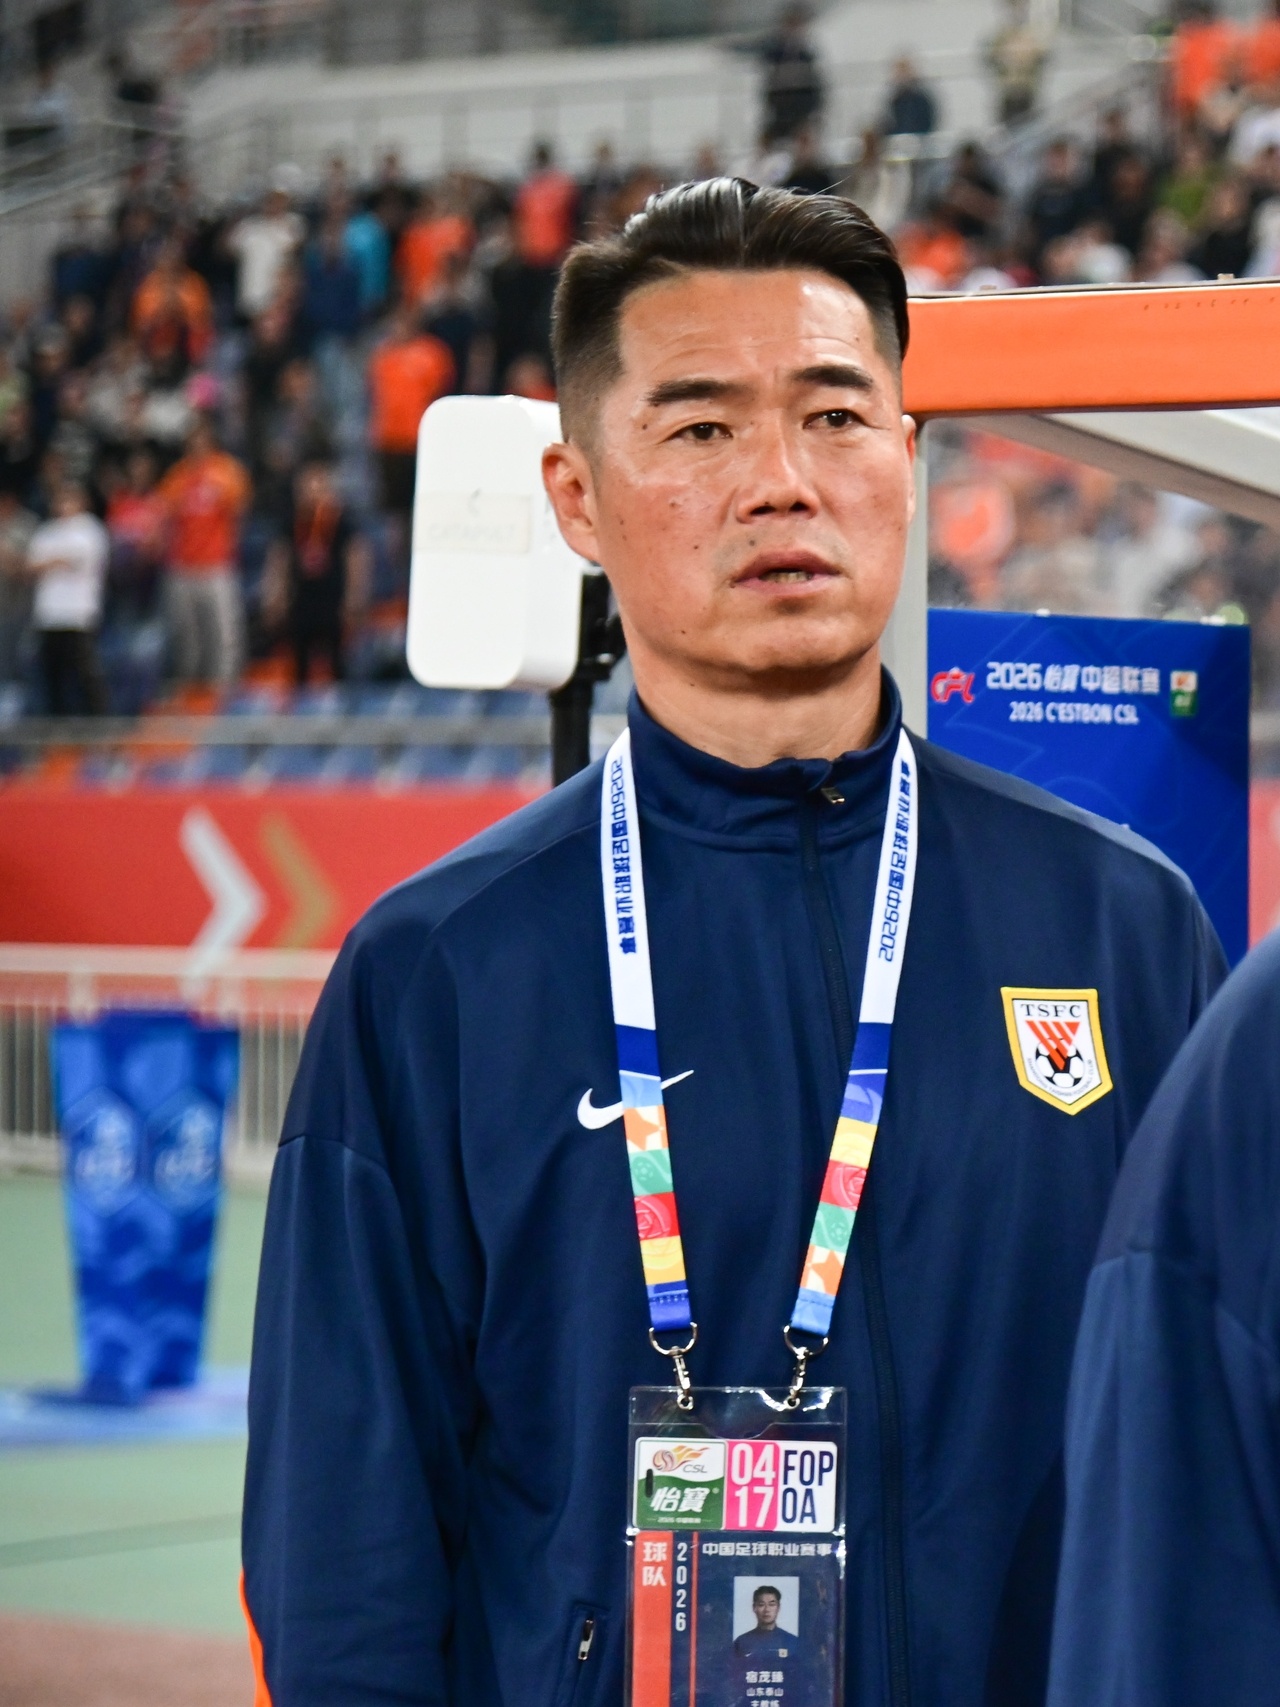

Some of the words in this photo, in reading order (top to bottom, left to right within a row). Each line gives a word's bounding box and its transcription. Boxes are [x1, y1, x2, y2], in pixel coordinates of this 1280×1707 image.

[1009, 701, 1043, 722] 2026
[1114, 703, 1140, 725] CSL
[1020, 1003, 1081, 1018] TSFC
[682, 1465, 708, 1474] CSL
[731, 1443, 775, 1486] 04
[783, 1450, 834, 1486] FOP
[734, 1486, 774, 1528] 17
[781, 1488, 817, 1524] OA
[642, 1541, 667, 1587] 球队
[702, 1542, 832, 1557] 中国足球职业赛事
[675, 1542, 688, 1632] 2026
